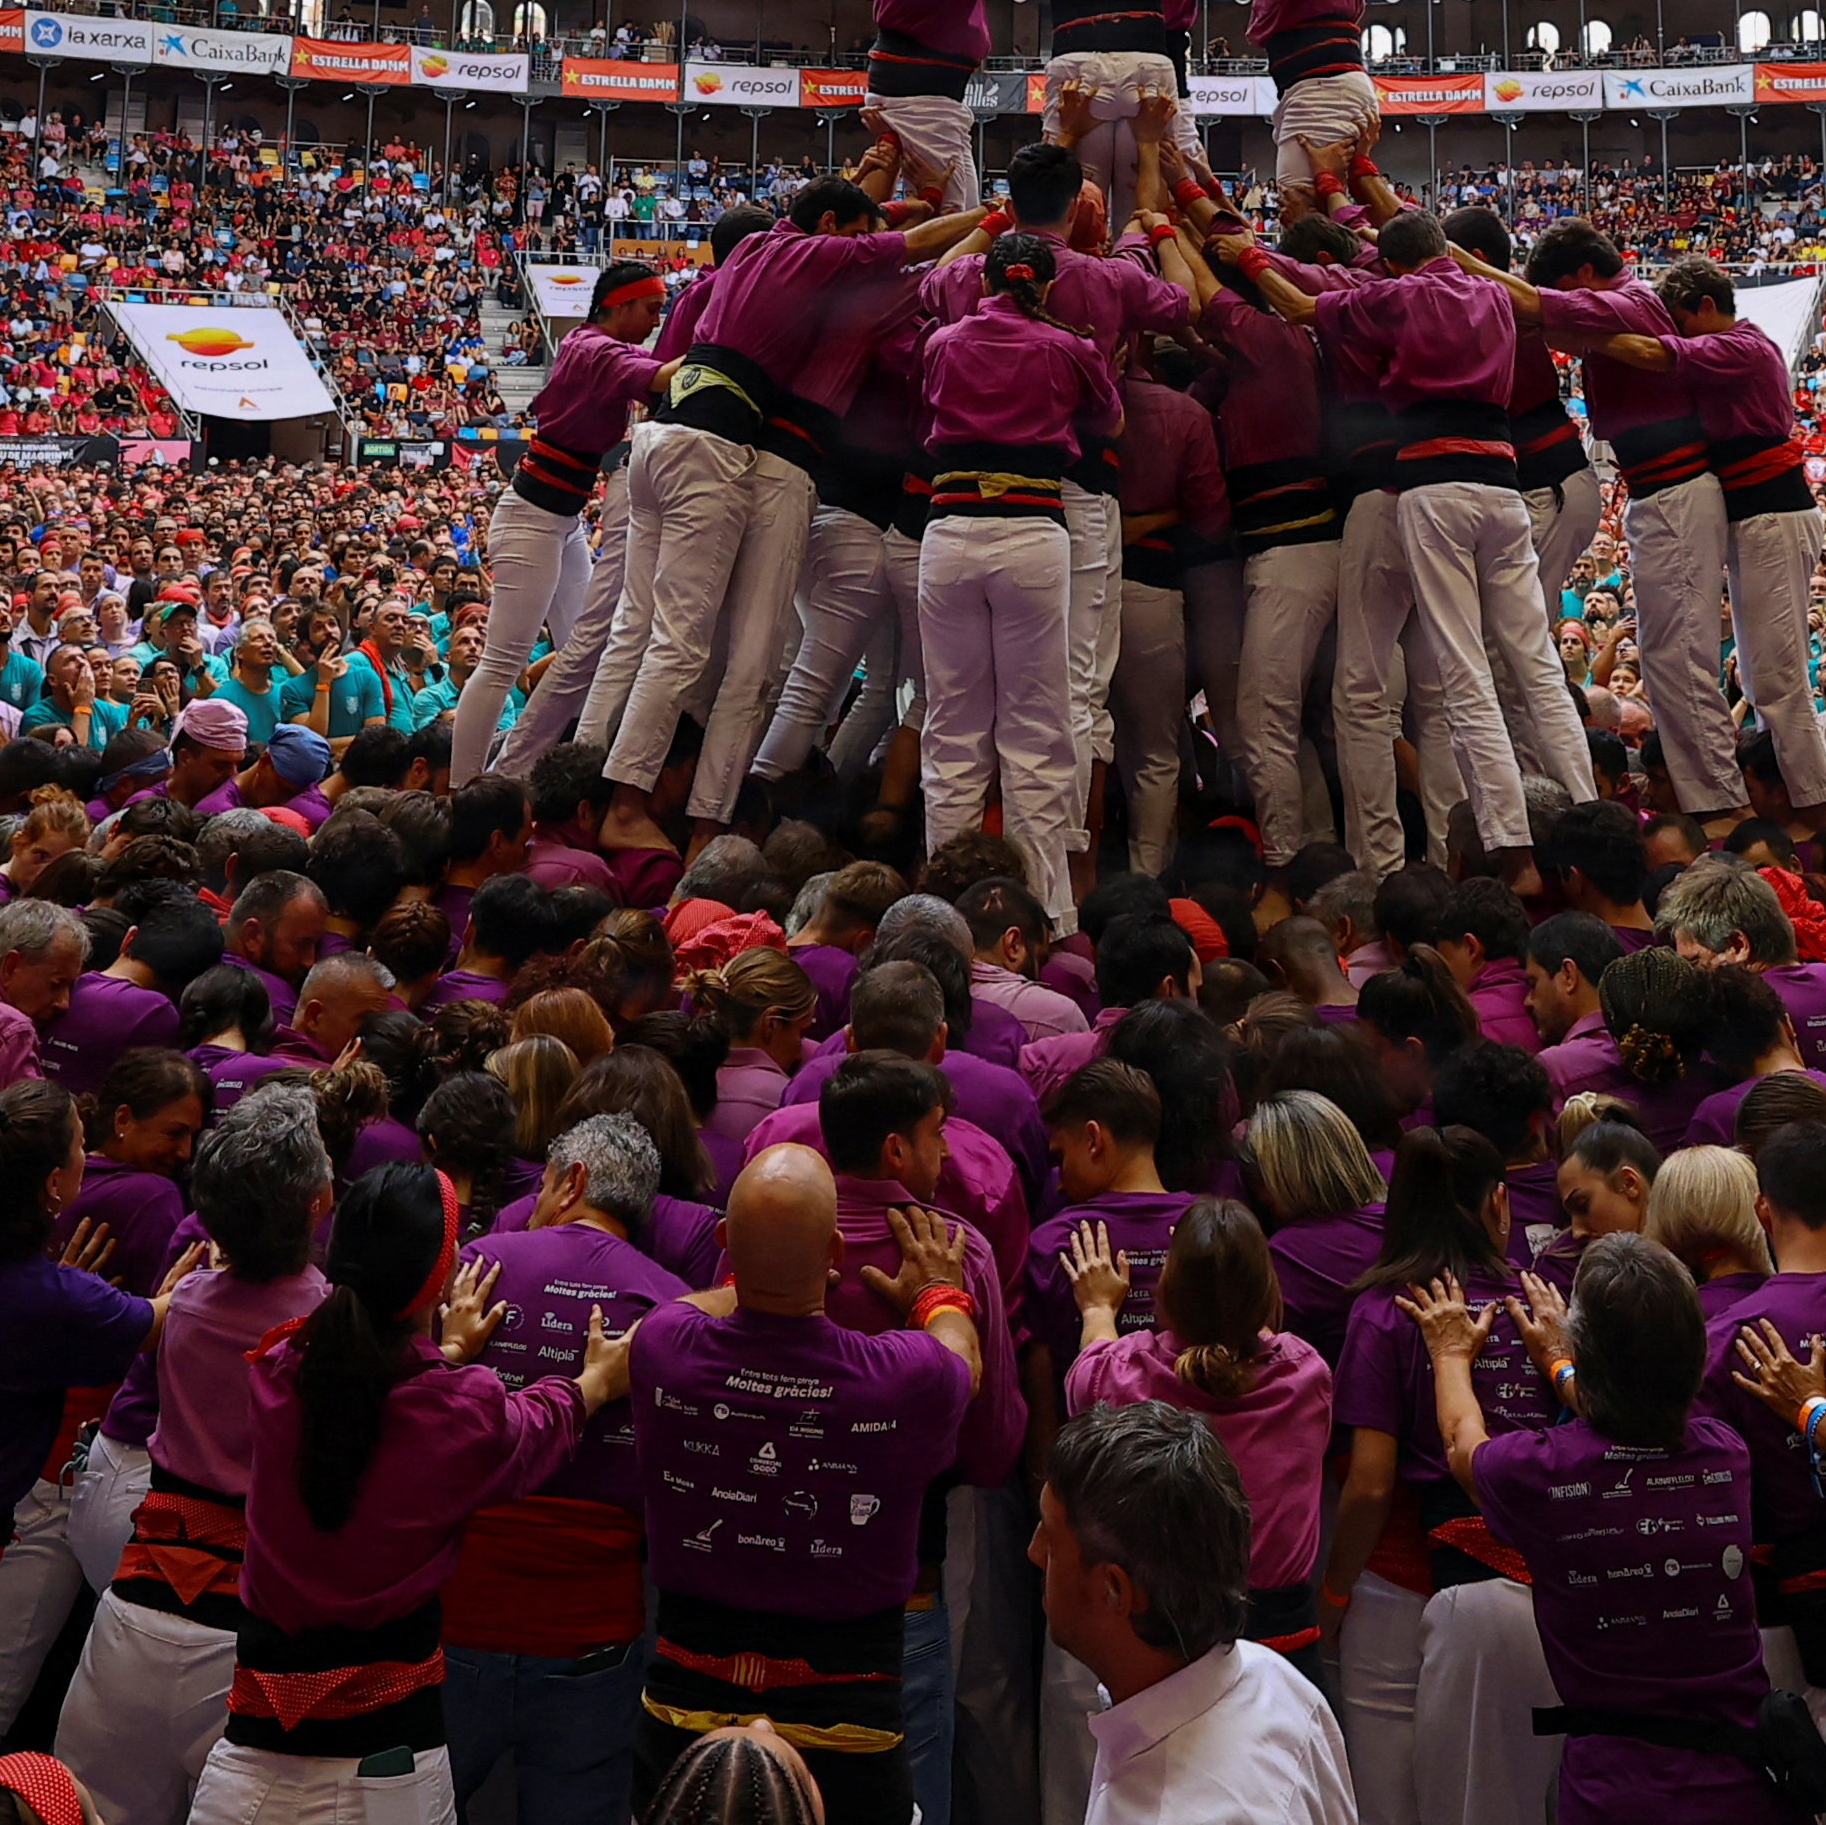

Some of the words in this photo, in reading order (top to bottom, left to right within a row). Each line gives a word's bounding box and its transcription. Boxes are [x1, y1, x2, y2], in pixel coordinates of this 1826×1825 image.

[67, 25, 86, 44] la
[90, 31, 147, 51] xarxa
[190, 38, 287, 65] CaixaBank
[311, 54, 369, 71] ESTRELLA
[371, 58, 410, 74] DAMM
[457, 62, 522, 82] repsol
[581, 73, 636, 88] ESTRELLA
[637, 76, 676, 90] DAMM
[731, 77, 793, 96] repsol
[1531, 81, 1595, 101] repsol
[1649, 75, 1746, 99] CaixaBank
[1189, 87, 1248, 106] repsol
[1387, 90, 1444, 103] ESTRELLA
[1444, 88, 1482, 101] DAMM
[181, 358, 269, 372] repsol
[8, 450, 22, 460] DE
[544, 1284, 577, 1297] Moltes
[577, 1288, 618, 1299] gràcies!
[725, 1374, 773, 1394] Moltes
[773, 1384, 834, 1399] gràcies!
[850, 1422, 888, 1434] AMIDA
